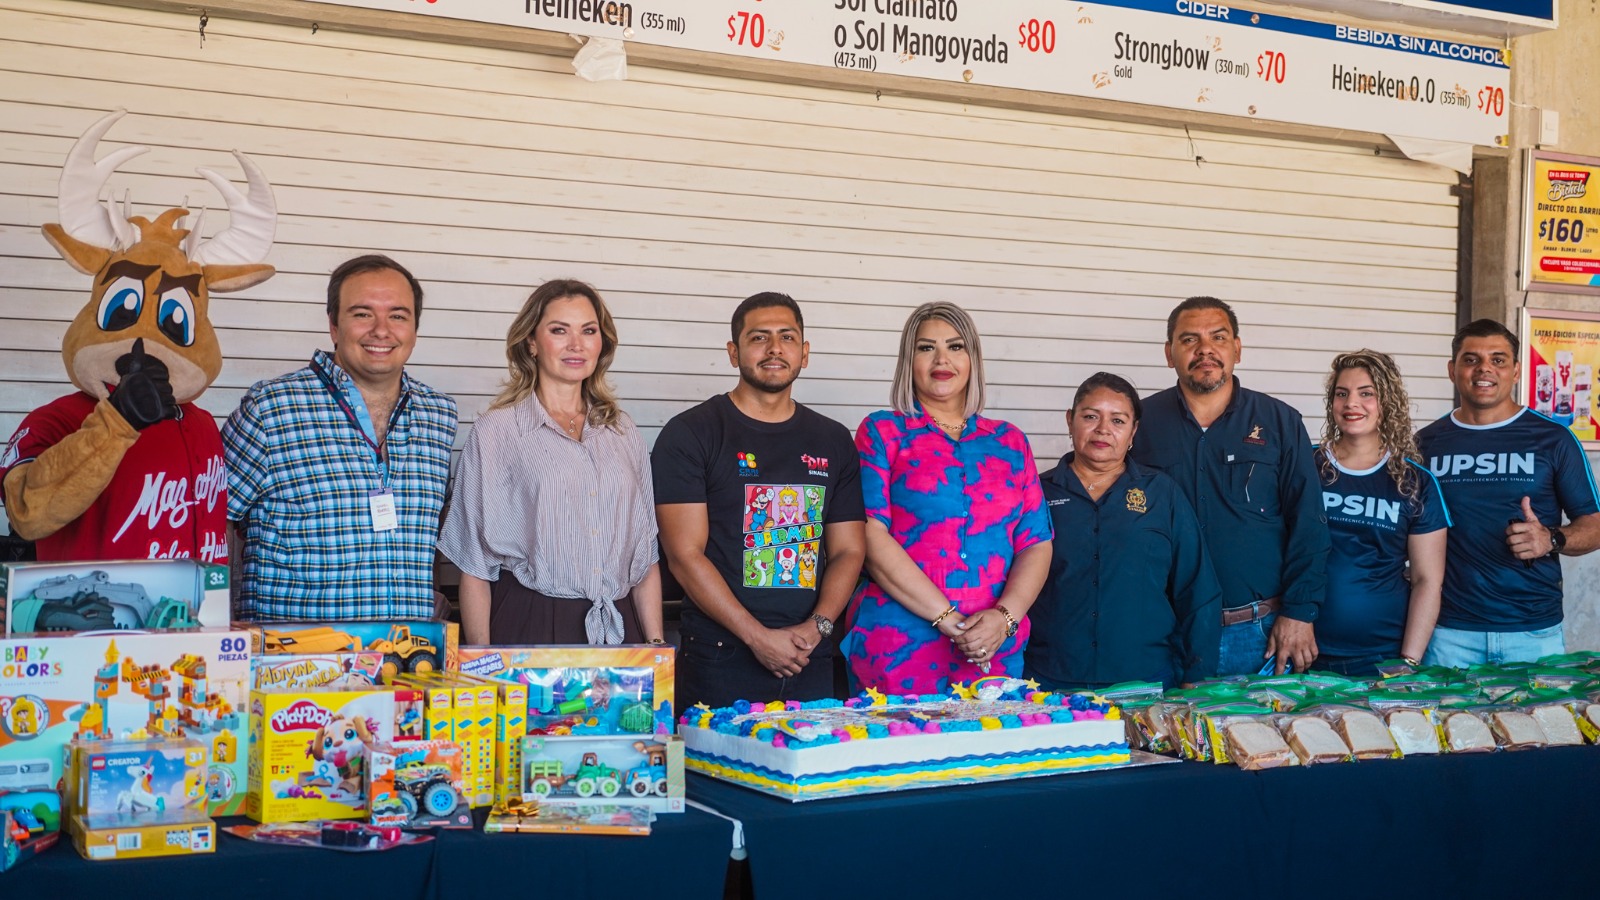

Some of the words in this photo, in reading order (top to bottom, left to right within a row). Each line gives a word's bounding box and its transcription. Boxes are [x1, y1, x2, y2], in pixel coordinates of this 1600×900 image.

[1175, 0, 1230, 20] CIDER
[641, 12, 664, 30] (355
[667, 16, 686, 34] ml)
[727, 11, 765, 48] $70
[834, 24, 847, 48] o
[854, 20, 886, 52] Sol
[893, 24, 1008, 64] Mangoyada
[1018, 18, 1056, 54] $80
[1335, 25, 1397, 48] BEBIDA
[1399, 33, 1425, 53] SIN
[1428, 40, 1503, 65] ALCOHOL
[834, 52, 856, 69] (473
[858, 55, 877, 72] ml)
[1114, 32, 1210, 71] Strongbow
[1215, 58, 1233, 76] (330
[1234, 60, 1250, 79] ml)
[1257, 50, 1287, 84] $70
[1114, 65, 1133, 79] Gold
[1332, 64, 1405, 100] Heineken
[1410, 76, 1436, 104] 0.0
[1440, 90, 1457, 106] (355
[1478, 86, 1505, 117] $70
[1538, 202, 1564, 212] DIRECTO
[1566, 205, 1577, 213] DEL
[1538, 217, 1584, 243] $160
[1534, 328, 1552, 337] LATAS
[1578, 331, 1600, 340] ESPECIA
[808, 456, 828, 470] DIF
[1430, 452, 1535, 477] UPSIN
[1322, 491, 1400, 525] PSIN
[743, 527, 788, 549] SUPER
[787, 522, 824, 543] MARIO
[209, 572, 225, 585] 3+
[5, 646, 49, 662] BABY
[220, 637, 246, 653] 80
[218, 653, 248, 661] PIEZAS
[0, 662, 62, 678] OLORS
[413, 691, 423, 700] 3+
[271, 705, 332, 730] Play-Doh
[107, 757, 141, 766] CREATOR
